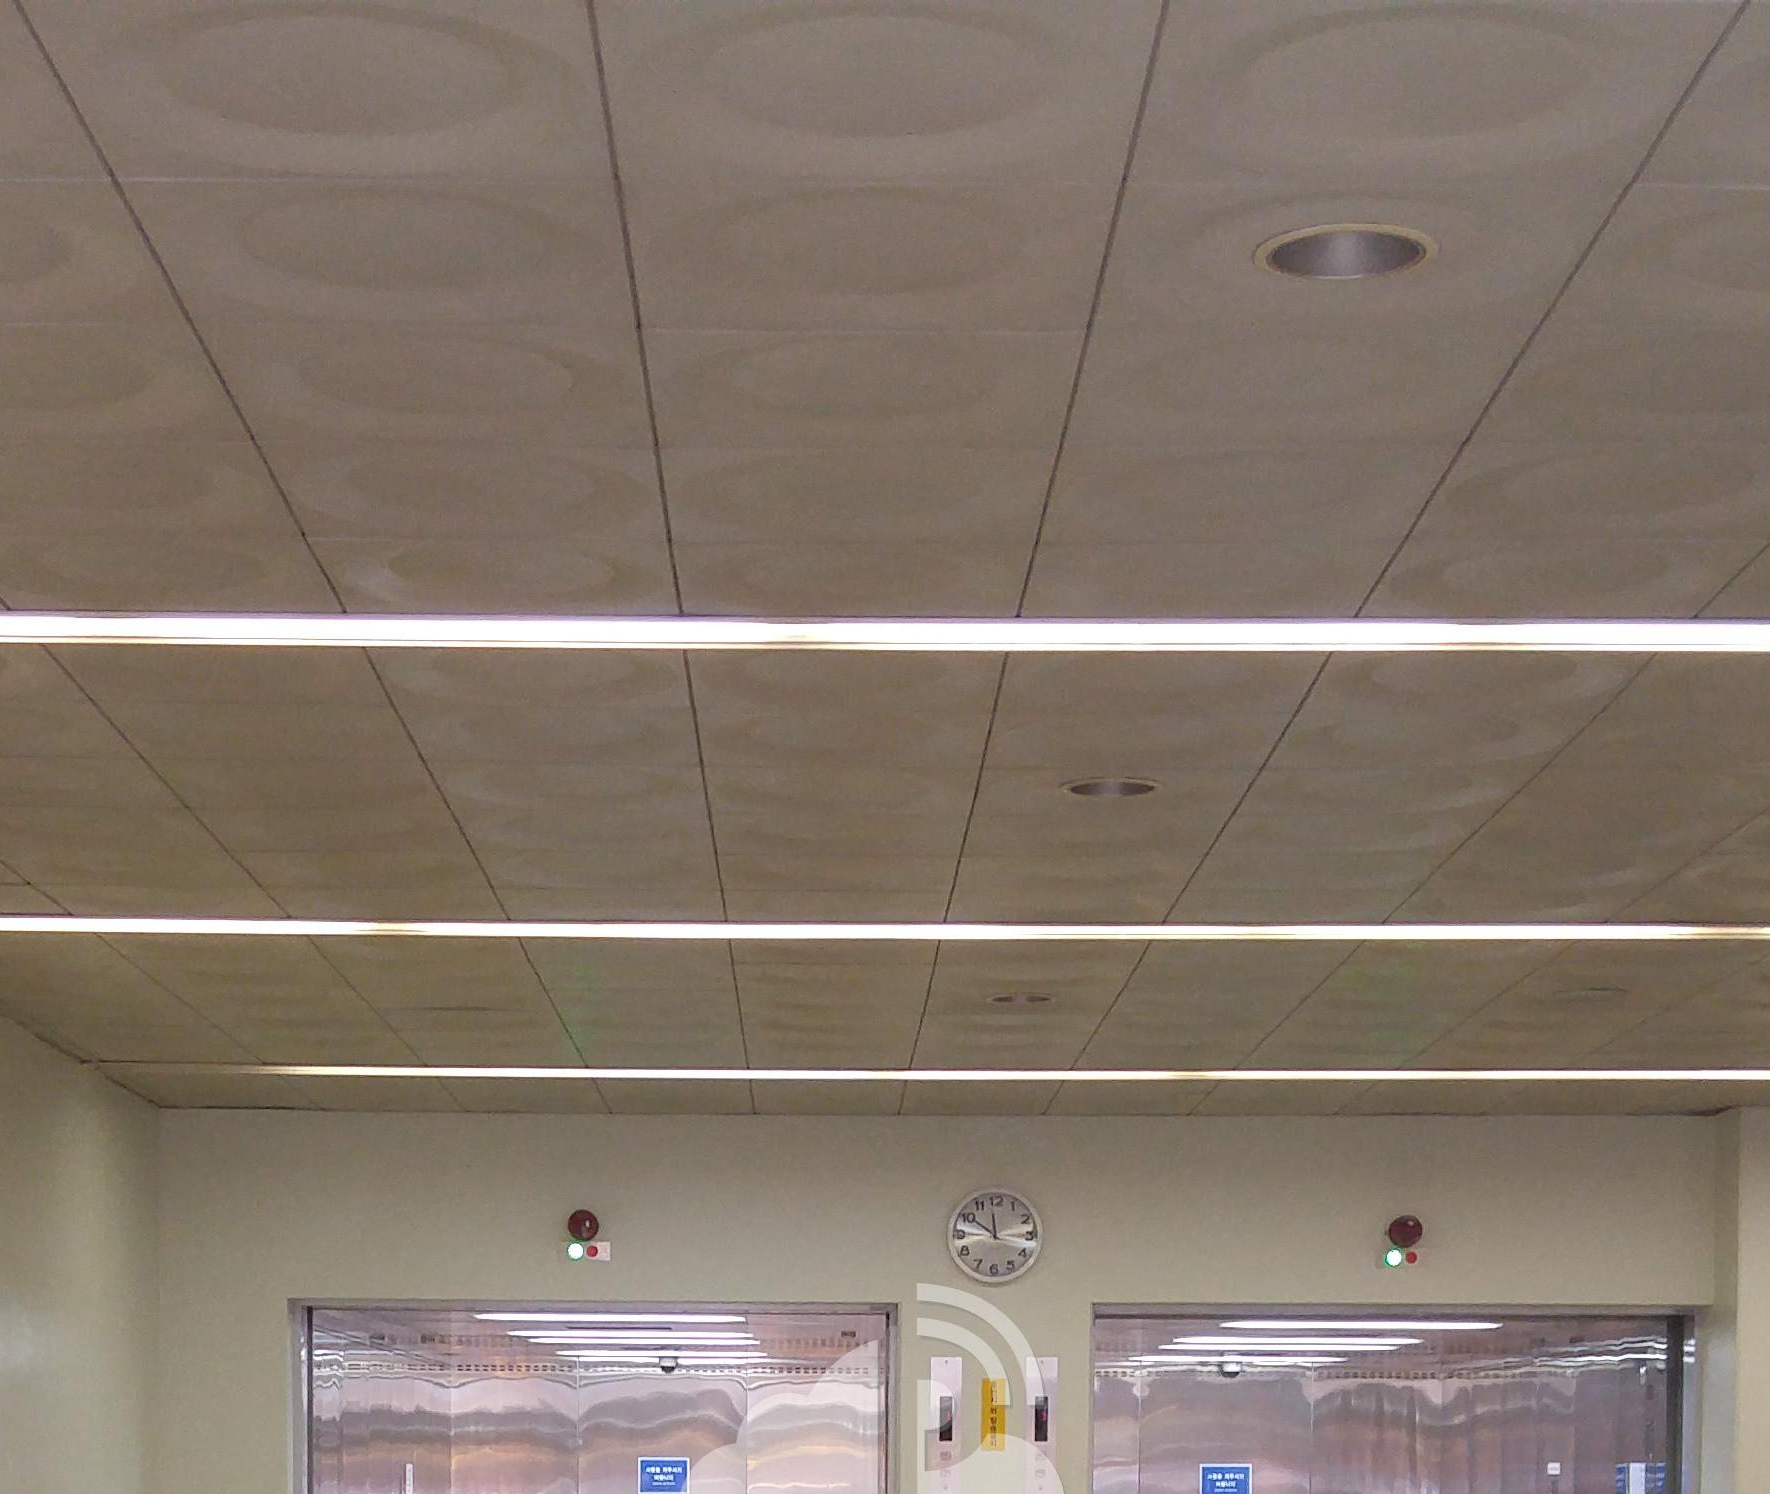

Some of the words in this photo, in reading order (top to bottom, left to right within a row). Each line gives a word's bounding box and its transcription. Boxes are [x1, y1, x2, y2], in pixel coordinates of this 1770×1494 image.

[975, 1200, 985, 1211] 11
[989, 1196, 1003, 1207] 12
[962, 1212, 975, 1223] 10
[1021, 1214, 1030, 1224] 2
[1025, 1230, 1034, 1241] 3
[960, 1245, 970, 1256] 8
[1018, 1248, 1027, 1258] 4
[973, 1258, 983, 1269] 7
[1006, 1260, 1015, 1270] 5
[989, 1264, 999, 1275] 6
